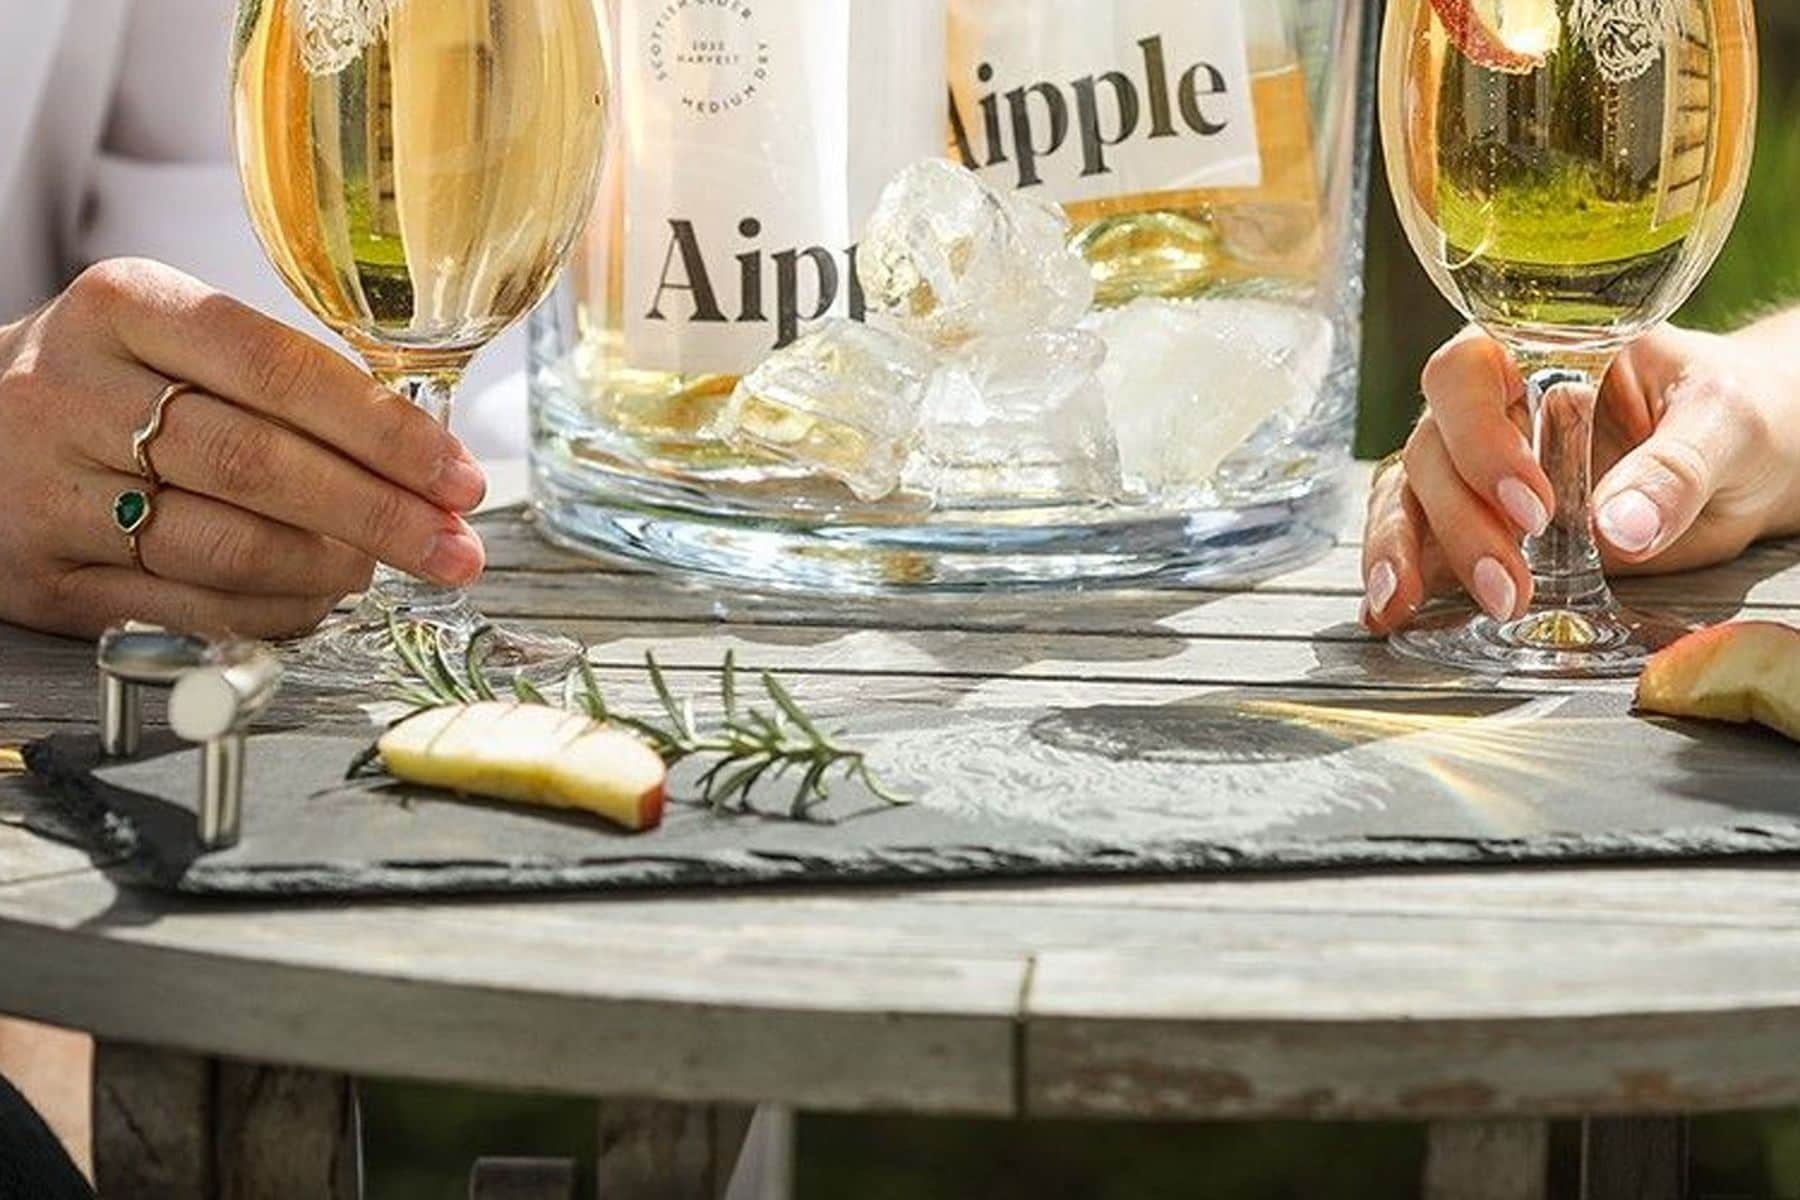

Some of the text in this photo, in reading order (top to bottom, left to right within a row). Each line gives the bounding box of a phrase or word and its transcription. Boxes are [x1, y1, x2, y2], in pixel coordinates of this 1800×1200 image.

[677, 54, 739, 65] HARVEST
[682, 43, 769, 114] MEDIUM DRY
